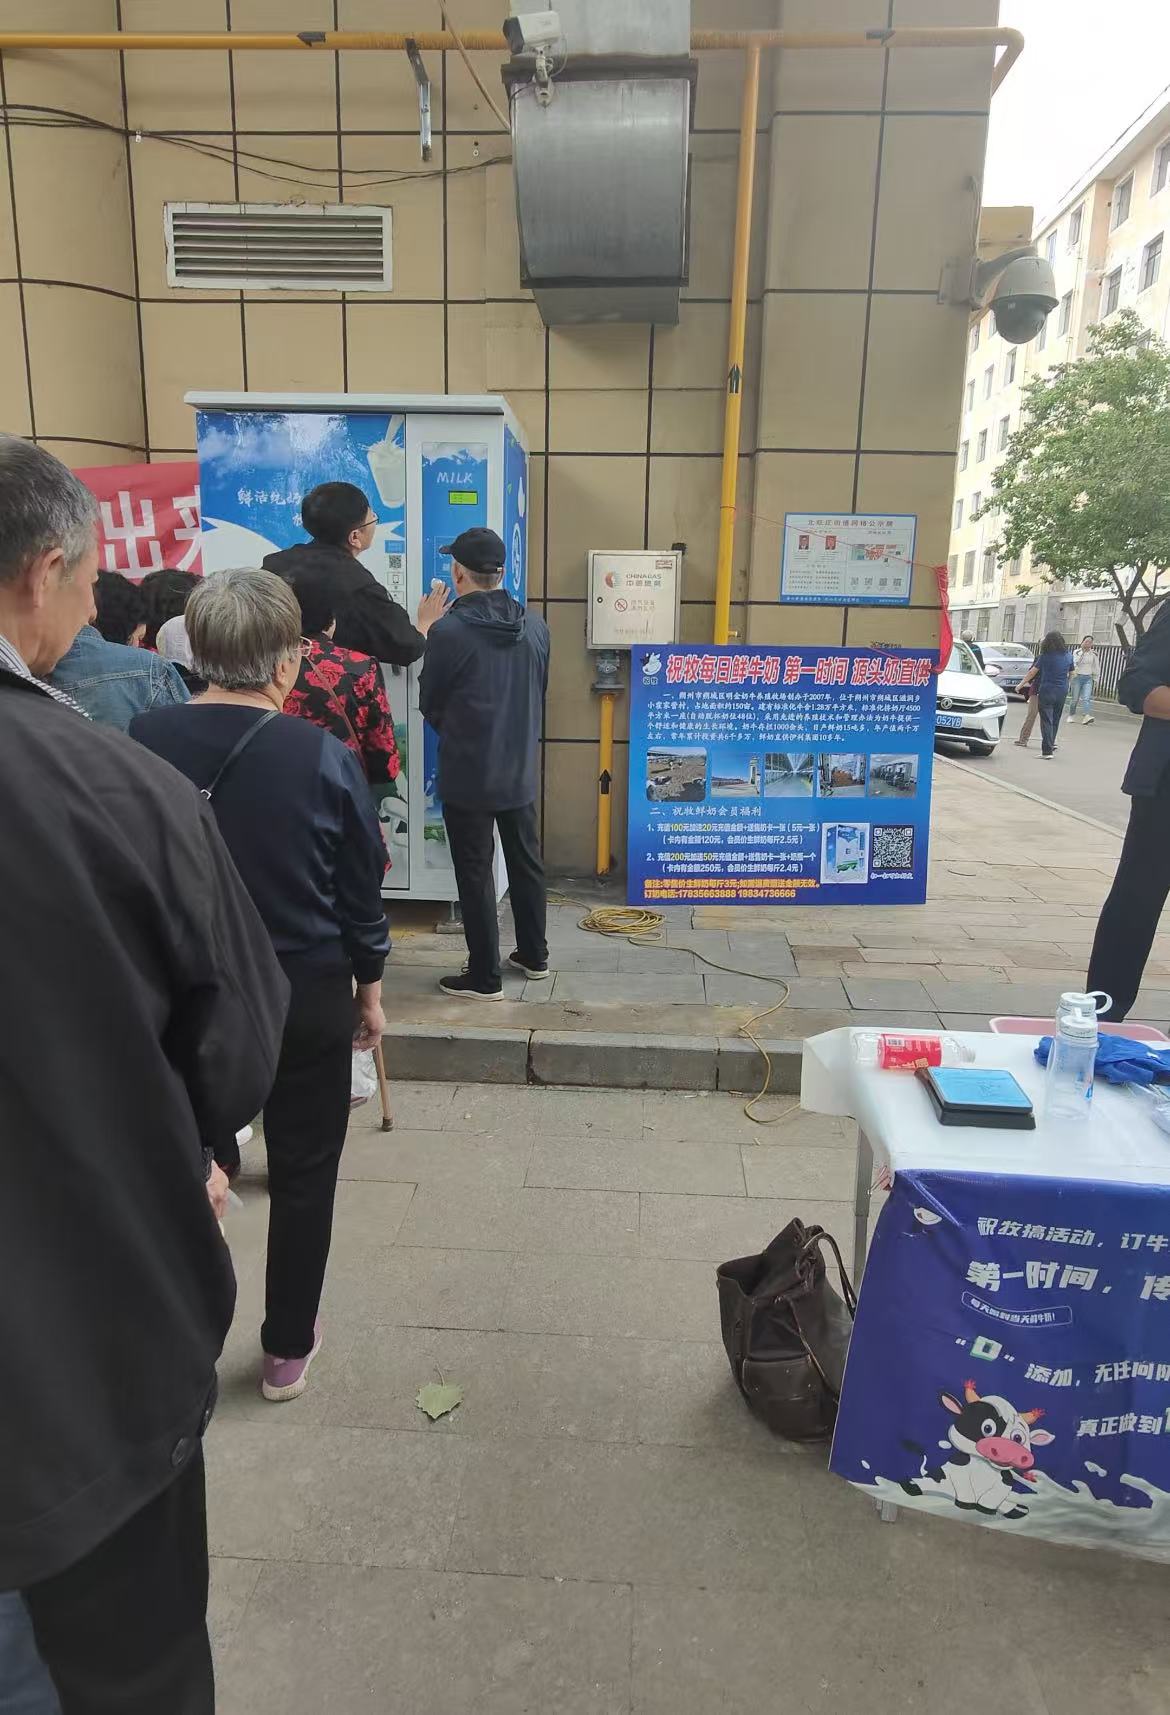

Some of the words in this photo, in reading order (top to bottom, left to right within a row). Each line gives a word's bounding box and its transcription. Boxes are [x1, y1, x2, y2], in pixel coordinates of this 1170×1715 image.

[436, 472, 473, 484] MILK
[666, 655, 780, 684] 祝牧每日鲜牛奶
[783, 656, 849, 685] 第一时间
[851, 658, 932, 686] 源头奶直供
[977, 1217, 1170, 1253] 祝牧搞活动，订牛
[1076, 1408, 1170, 1437] 真正做到
